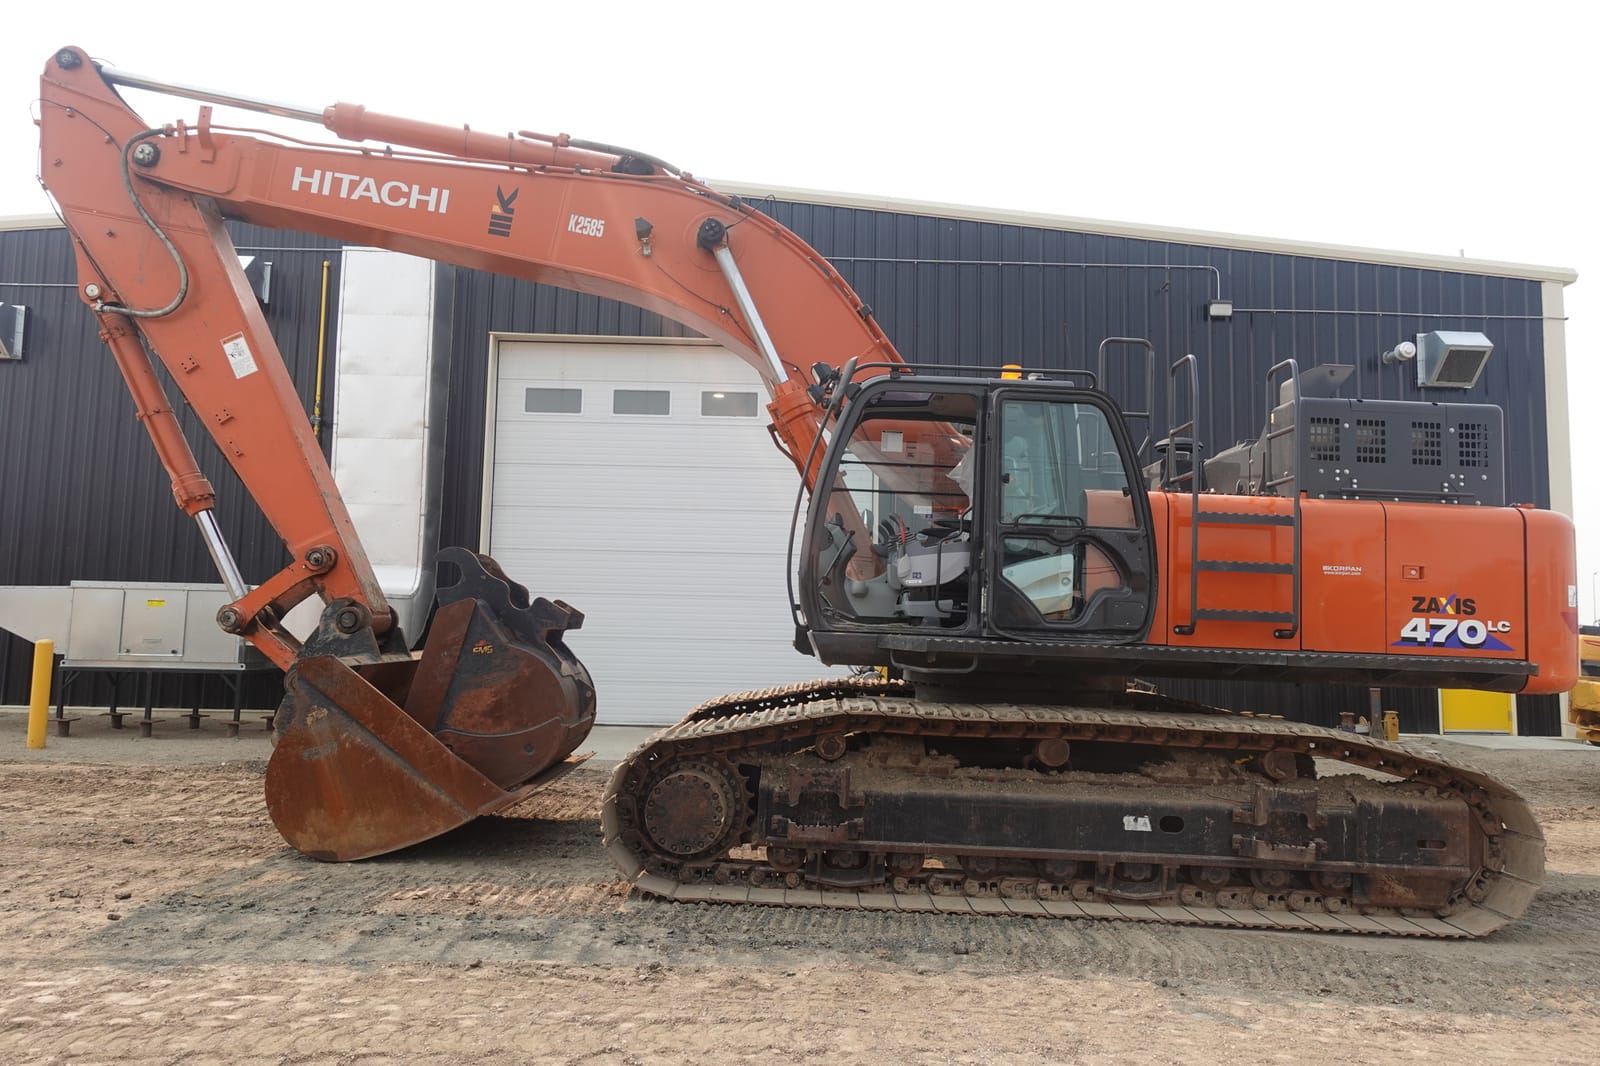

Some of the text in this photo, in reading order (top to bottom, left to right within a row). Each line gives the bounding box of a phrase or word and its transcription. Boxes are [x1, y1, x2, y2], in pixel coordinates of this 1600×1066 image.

[291, 166, 450, 214] HITACHI
[567, 213, 605, 238] K2585
[1411, 593, 1476, 616] ZAXIS
[1400, 617, 1487, 649] 470
